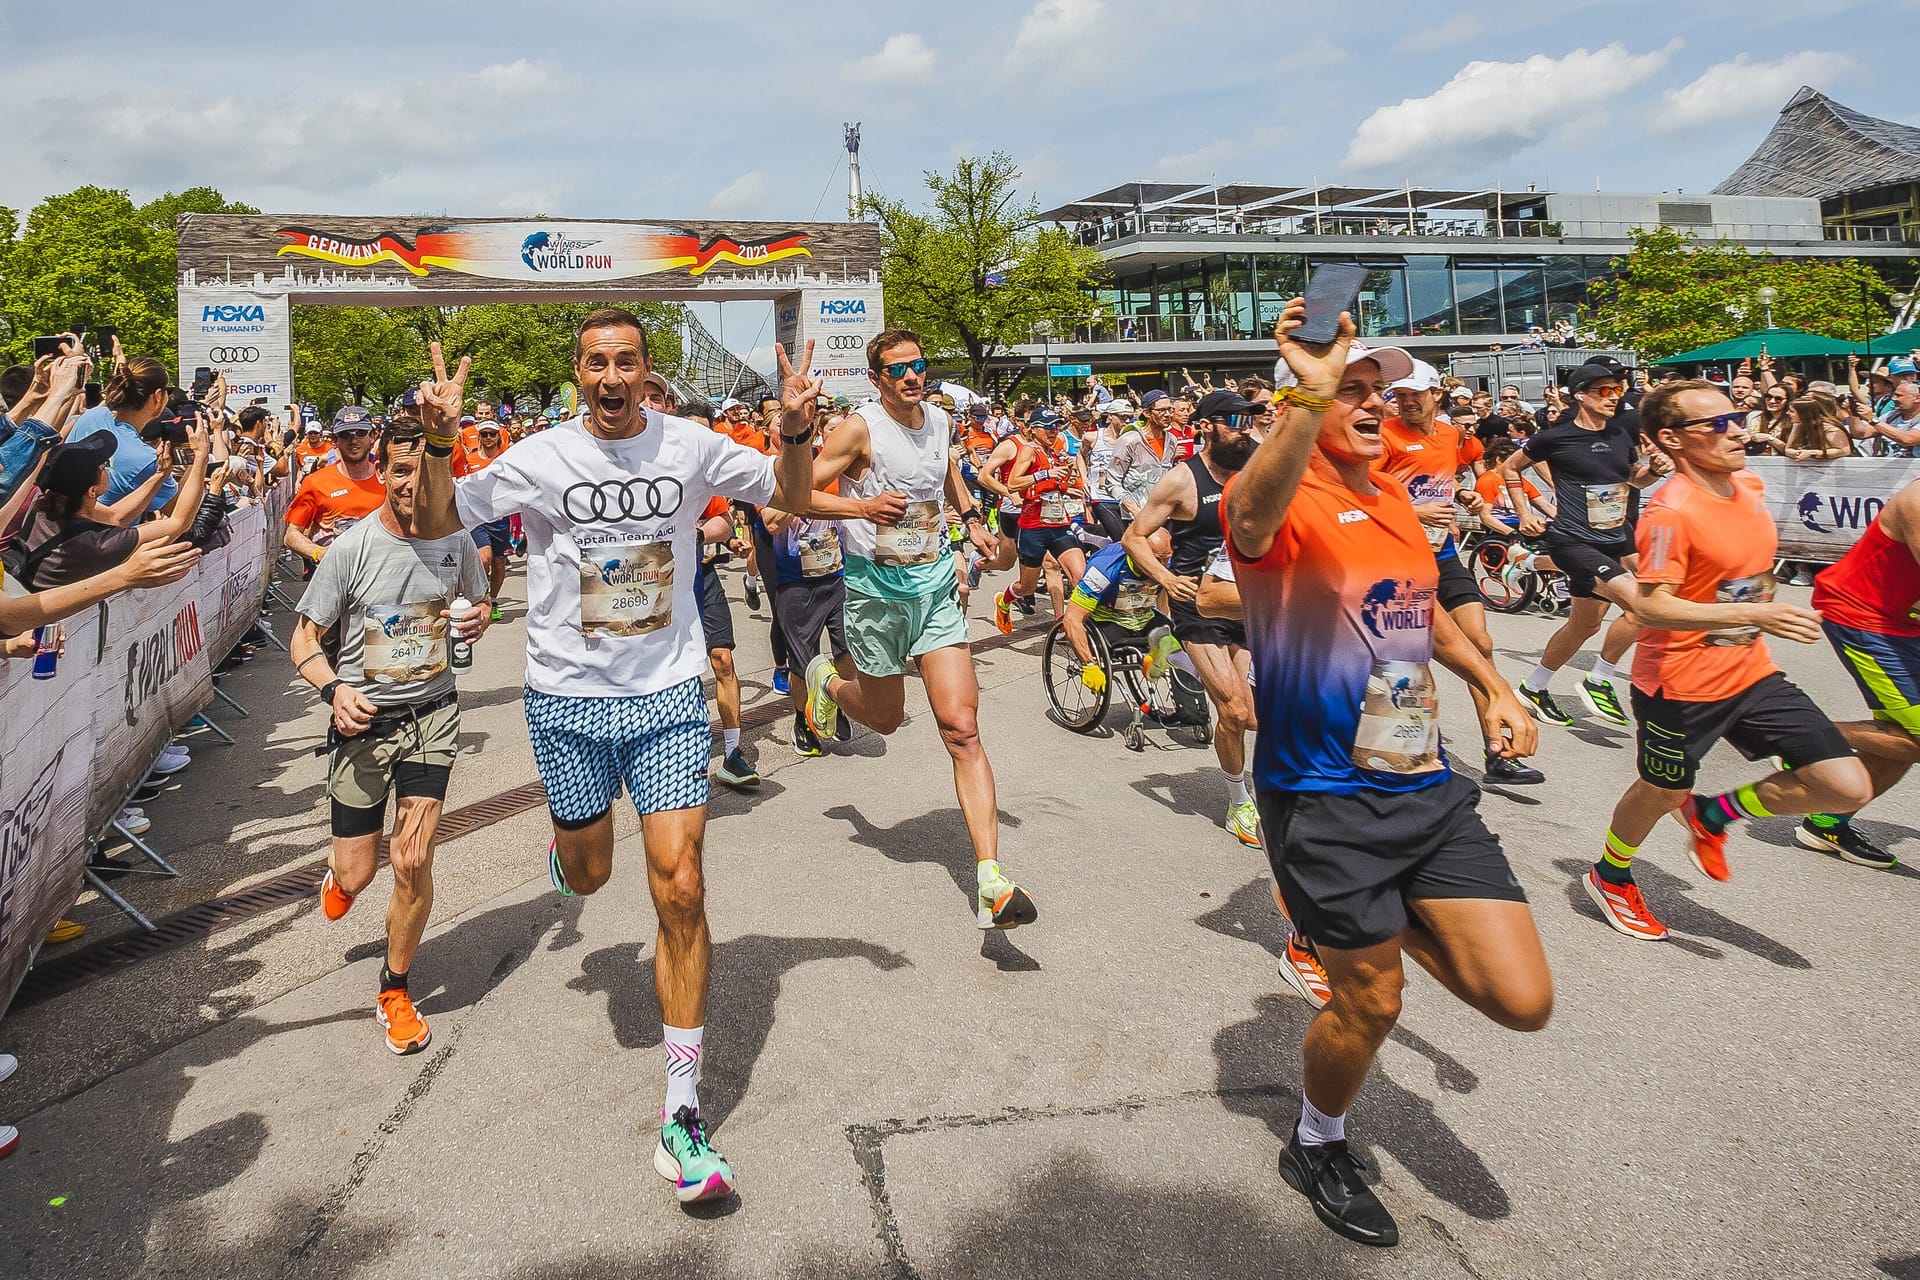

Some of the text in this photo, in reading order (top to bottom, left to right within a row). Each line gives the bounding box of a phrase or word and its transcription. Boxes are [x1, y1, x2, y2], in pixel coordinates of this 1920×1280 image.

[307, 235, 383, 260] GERMANY
[549, 241, 582, 249] WINGS
[737, 245, 769, 260] 2023
[537, 255, 612, 269] WORLD RUN
[202, 305, 265, 322] HOKA
[820, 300, 866, 314] HOKA
[822, 368, 868, 377] INTERSPO
[226, 384, 278, 394] ERSPORT
[1202, 493, 1222, 504] HOK
[620, 533, 655, 541] Team
[655, 524, 676, 539] Audi
[611, 572, 643, 585] WORLD
[642, 569, 659, 581] RUN
[612, 594, 649, 610] 28698
[391, 623, 433, 637] WORLD RUN
[138, 600, 202, 707] WORLD RUN
[391, 645, 424, 658] 26417
